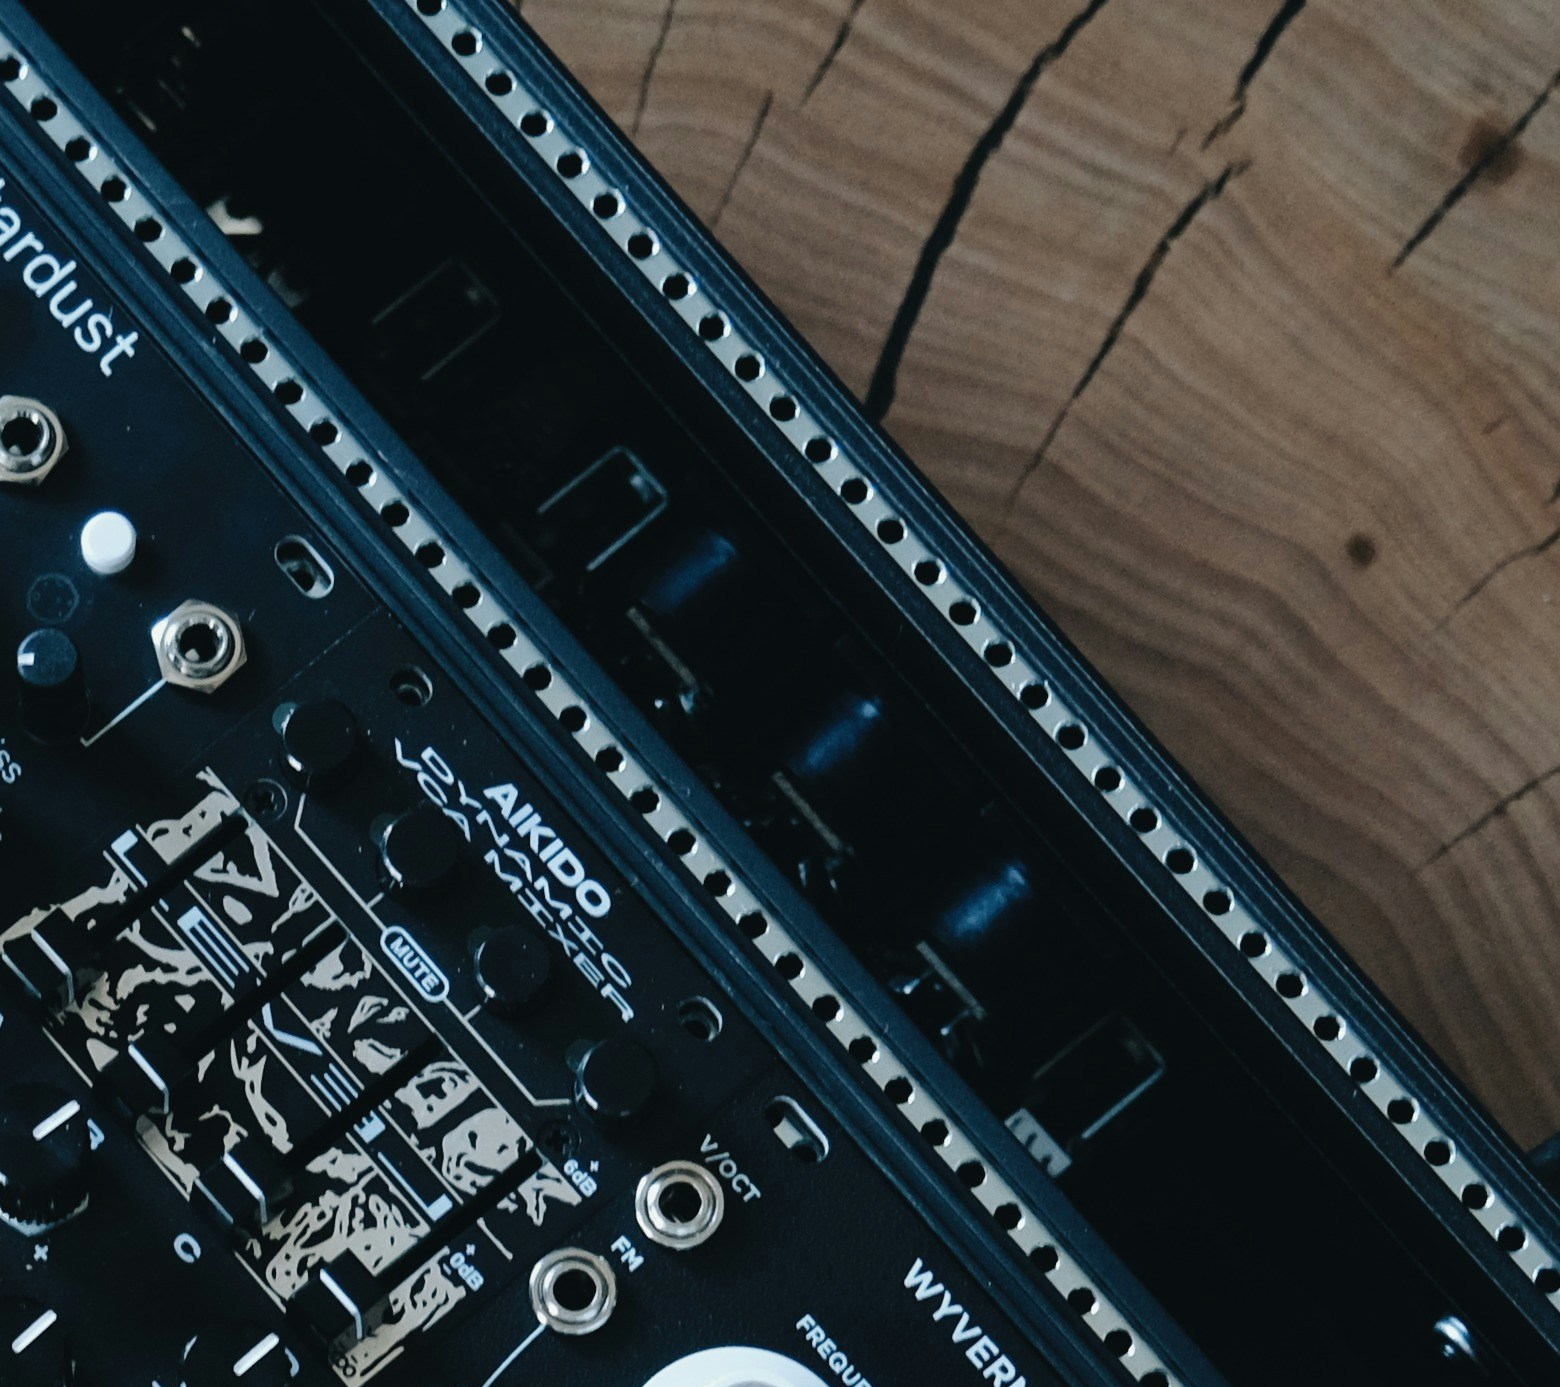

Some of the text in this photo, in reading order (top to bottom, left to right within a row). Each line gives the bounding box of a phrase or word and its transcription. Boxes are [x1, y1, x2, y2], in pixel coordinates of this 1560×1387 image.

[392, 736, 636, 1025] VCA MIXER
[418, 745, 633, 1001] DYNAMIC
[480, 781, 613, 920] AIKIDO
[383, 932, 445, 997] MUTE
[698, 1132, 762, 1204] V/OCT
[608, 1234, 646, 1274] FM
